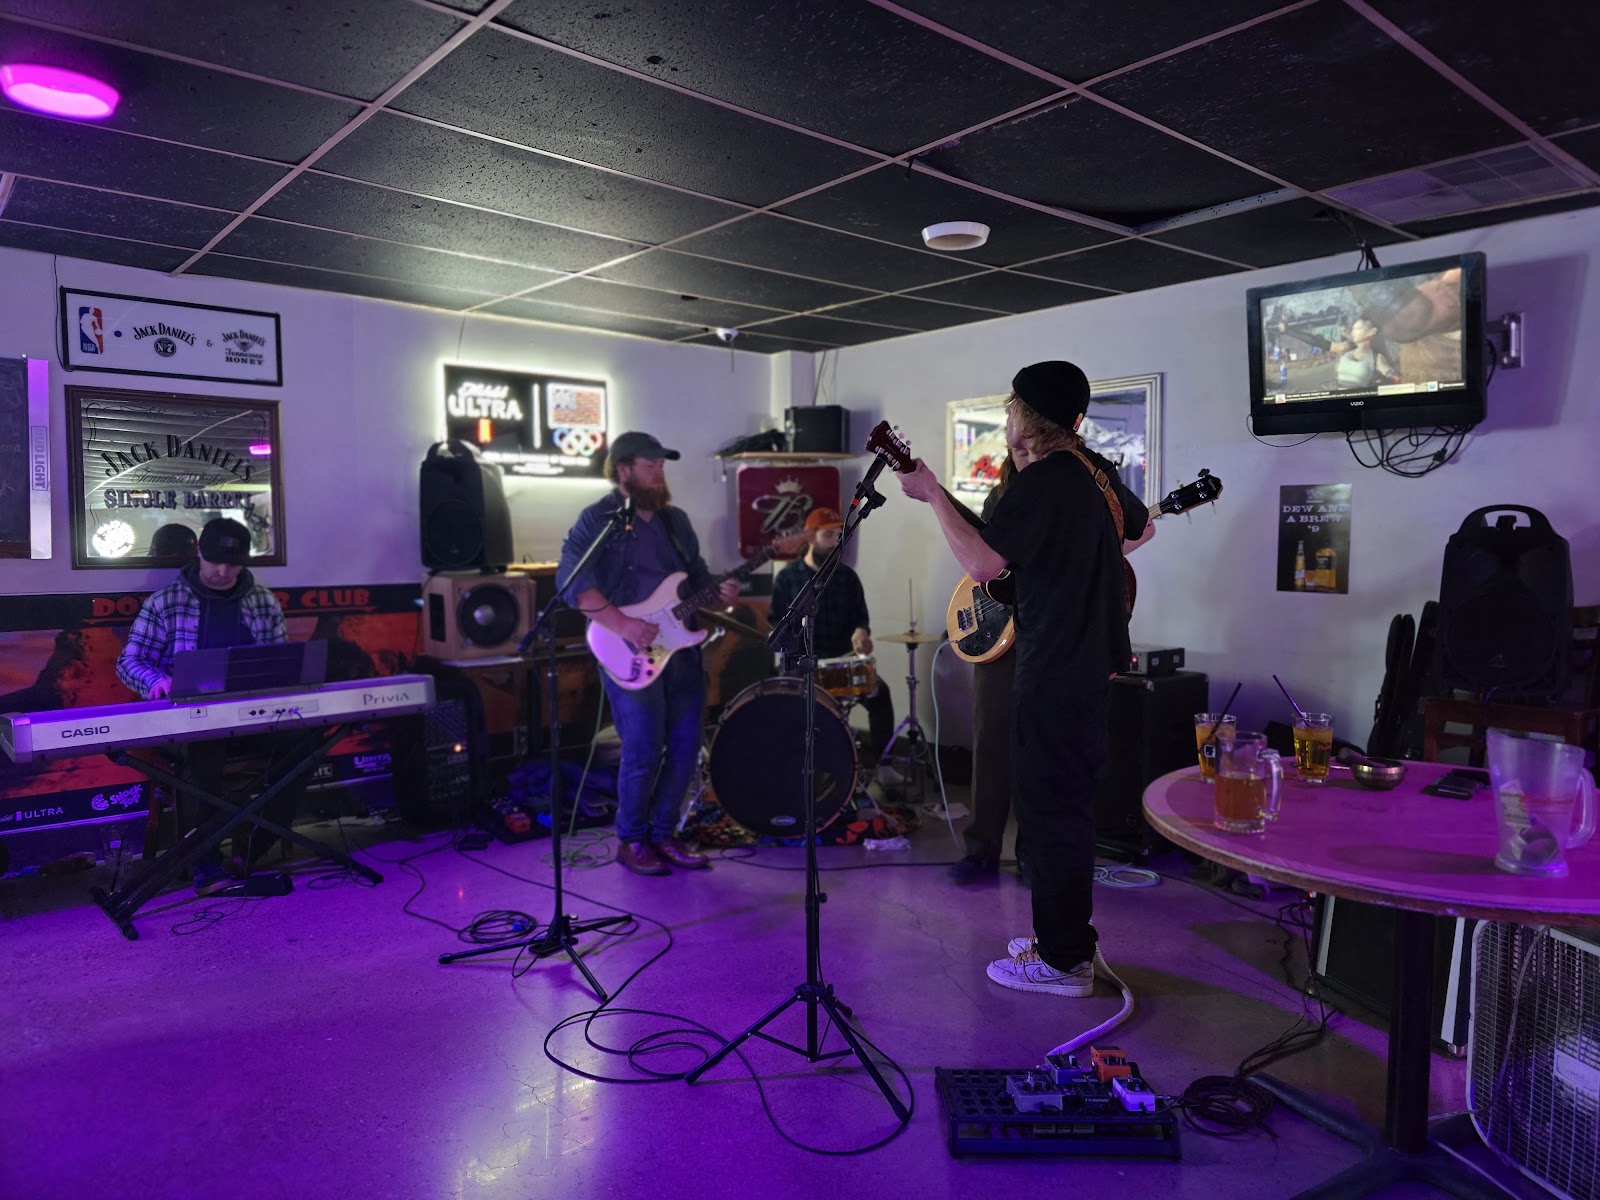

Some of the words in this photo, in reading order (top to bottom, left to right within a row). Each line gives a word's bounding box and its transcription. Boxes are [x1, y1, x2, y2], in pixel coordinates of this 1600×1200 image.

[133, 325, 158, 341] JACK
[82, 342, 96, 352] NBA
[205, 339, 214, 348] &
[225, 356, 264, 366] HONEY
[448, 393, 523, 421] ULTRA
[101, 440, 162, 477] JACK
[34, 454, 46, 489] LIGHT
[104, 488, 177, 509] SINGLE
[1282, 505, 1313, 513] DEW
[1286, 515, 1296, 523] A
[1299, 515, 1342, 523] BREW
[300, 588, 369, 608] CLUB
[363, 692, 410, 706] Privia
[61, 725, 110, 739] CASIO
[109, 784, 143, 805] SHOCK
[24, 807, 64, 819] ULTRA
